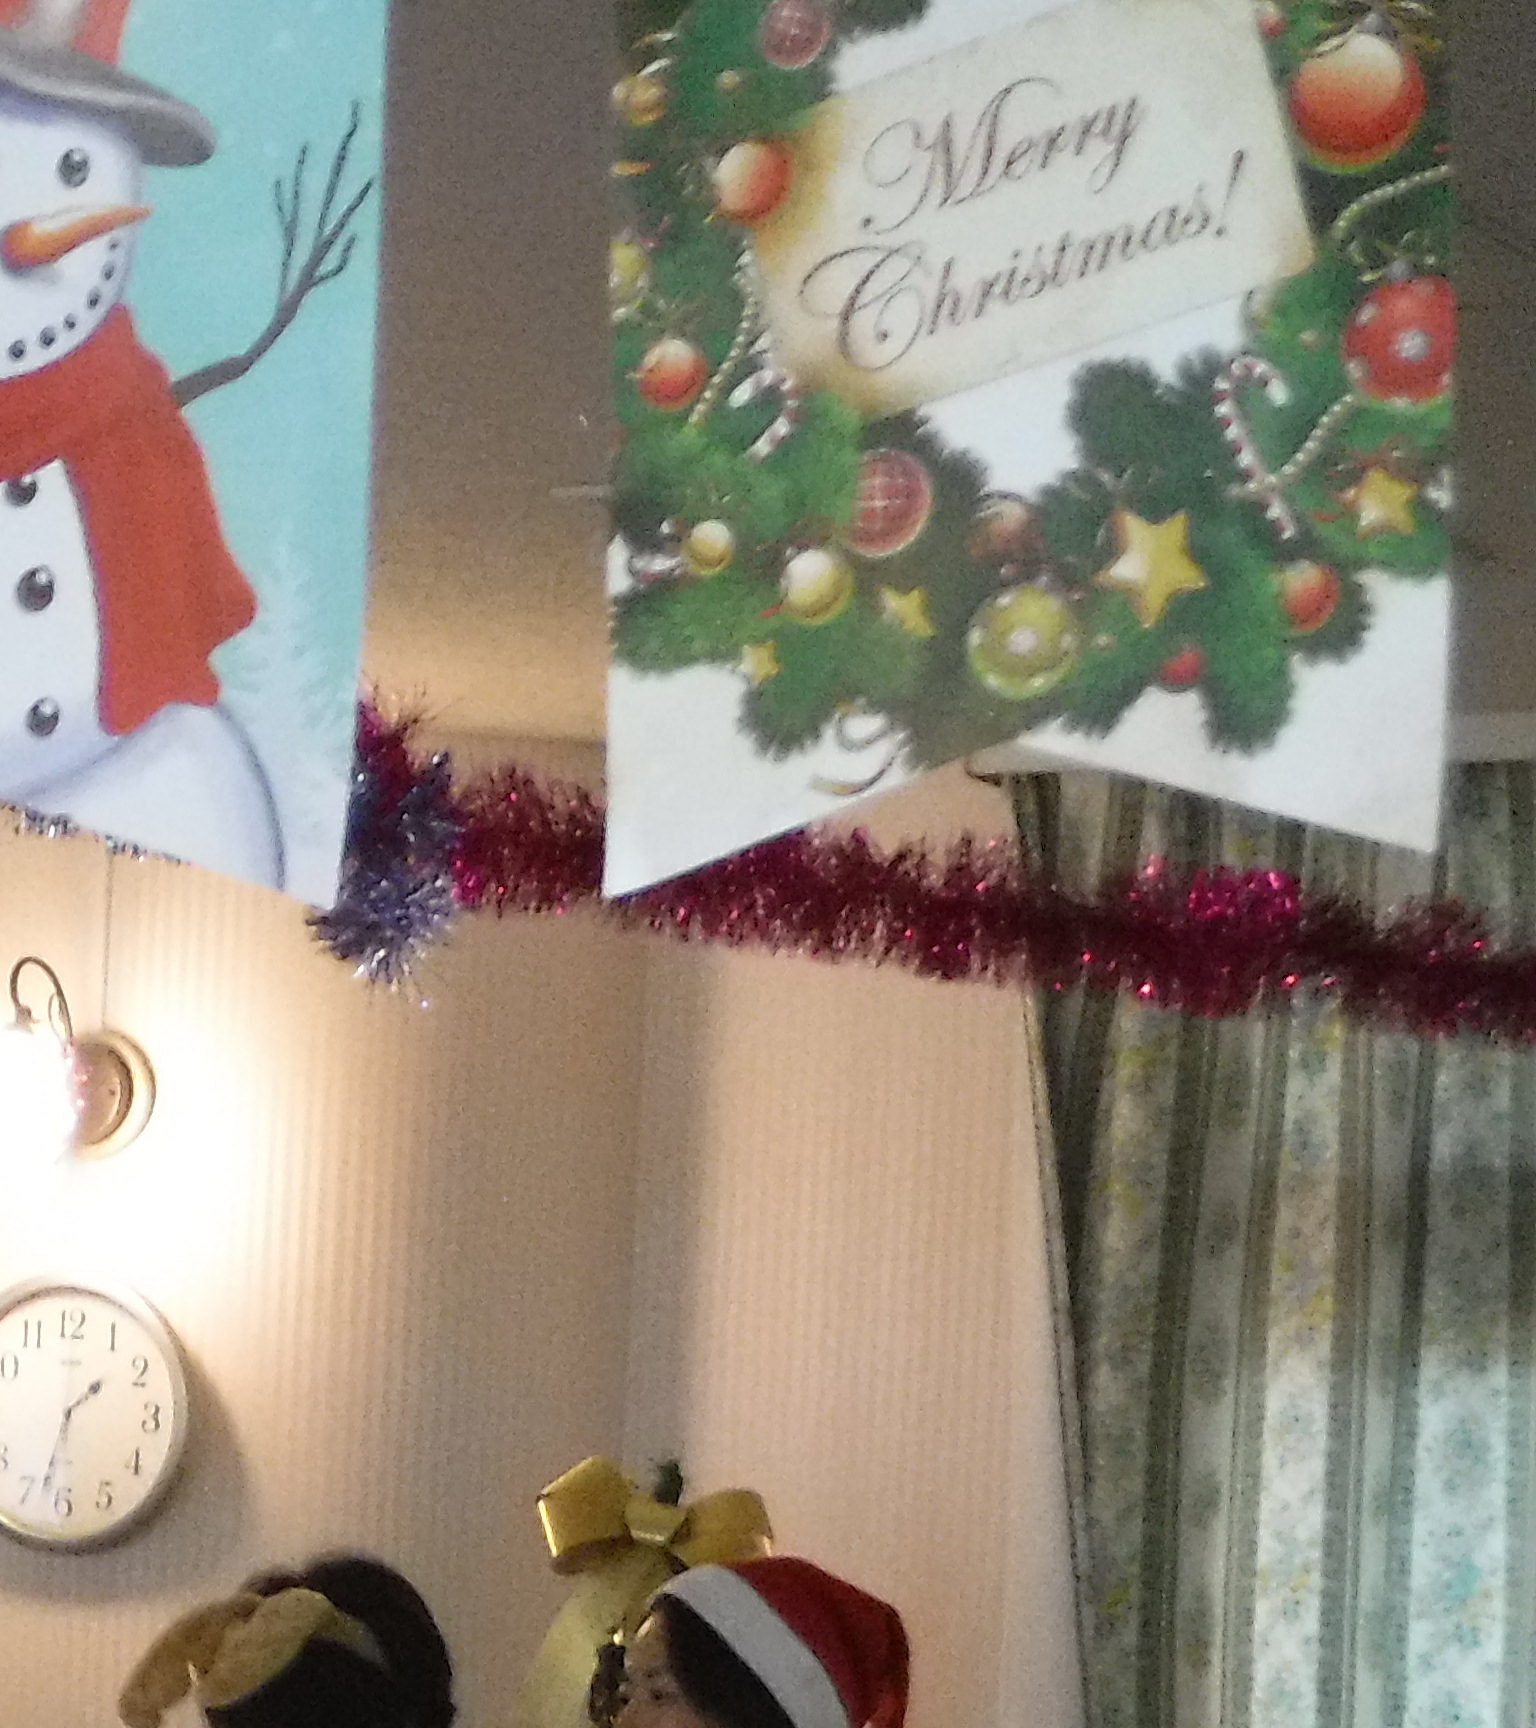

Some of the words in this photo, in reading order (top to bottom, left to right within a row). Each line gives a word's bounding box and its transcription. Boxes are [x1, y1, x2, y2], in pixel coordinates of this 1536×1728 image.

[862, 76, 1144, 238] Merry
[798, 150, 1246, 370] Christmas!
[23, 1319, 42, 1349] 11
[59, 1308, 86, 1340] 12
[132, 1355, 149, 1388] 2
[141, 1402, 161, 1433] 3
[125, 1446, 142, 1476] 4
[19, 1475, 35, 1505] 7
[54, 1486, 74, 1518] 6
[95, 1480, 114, 1510] 5
